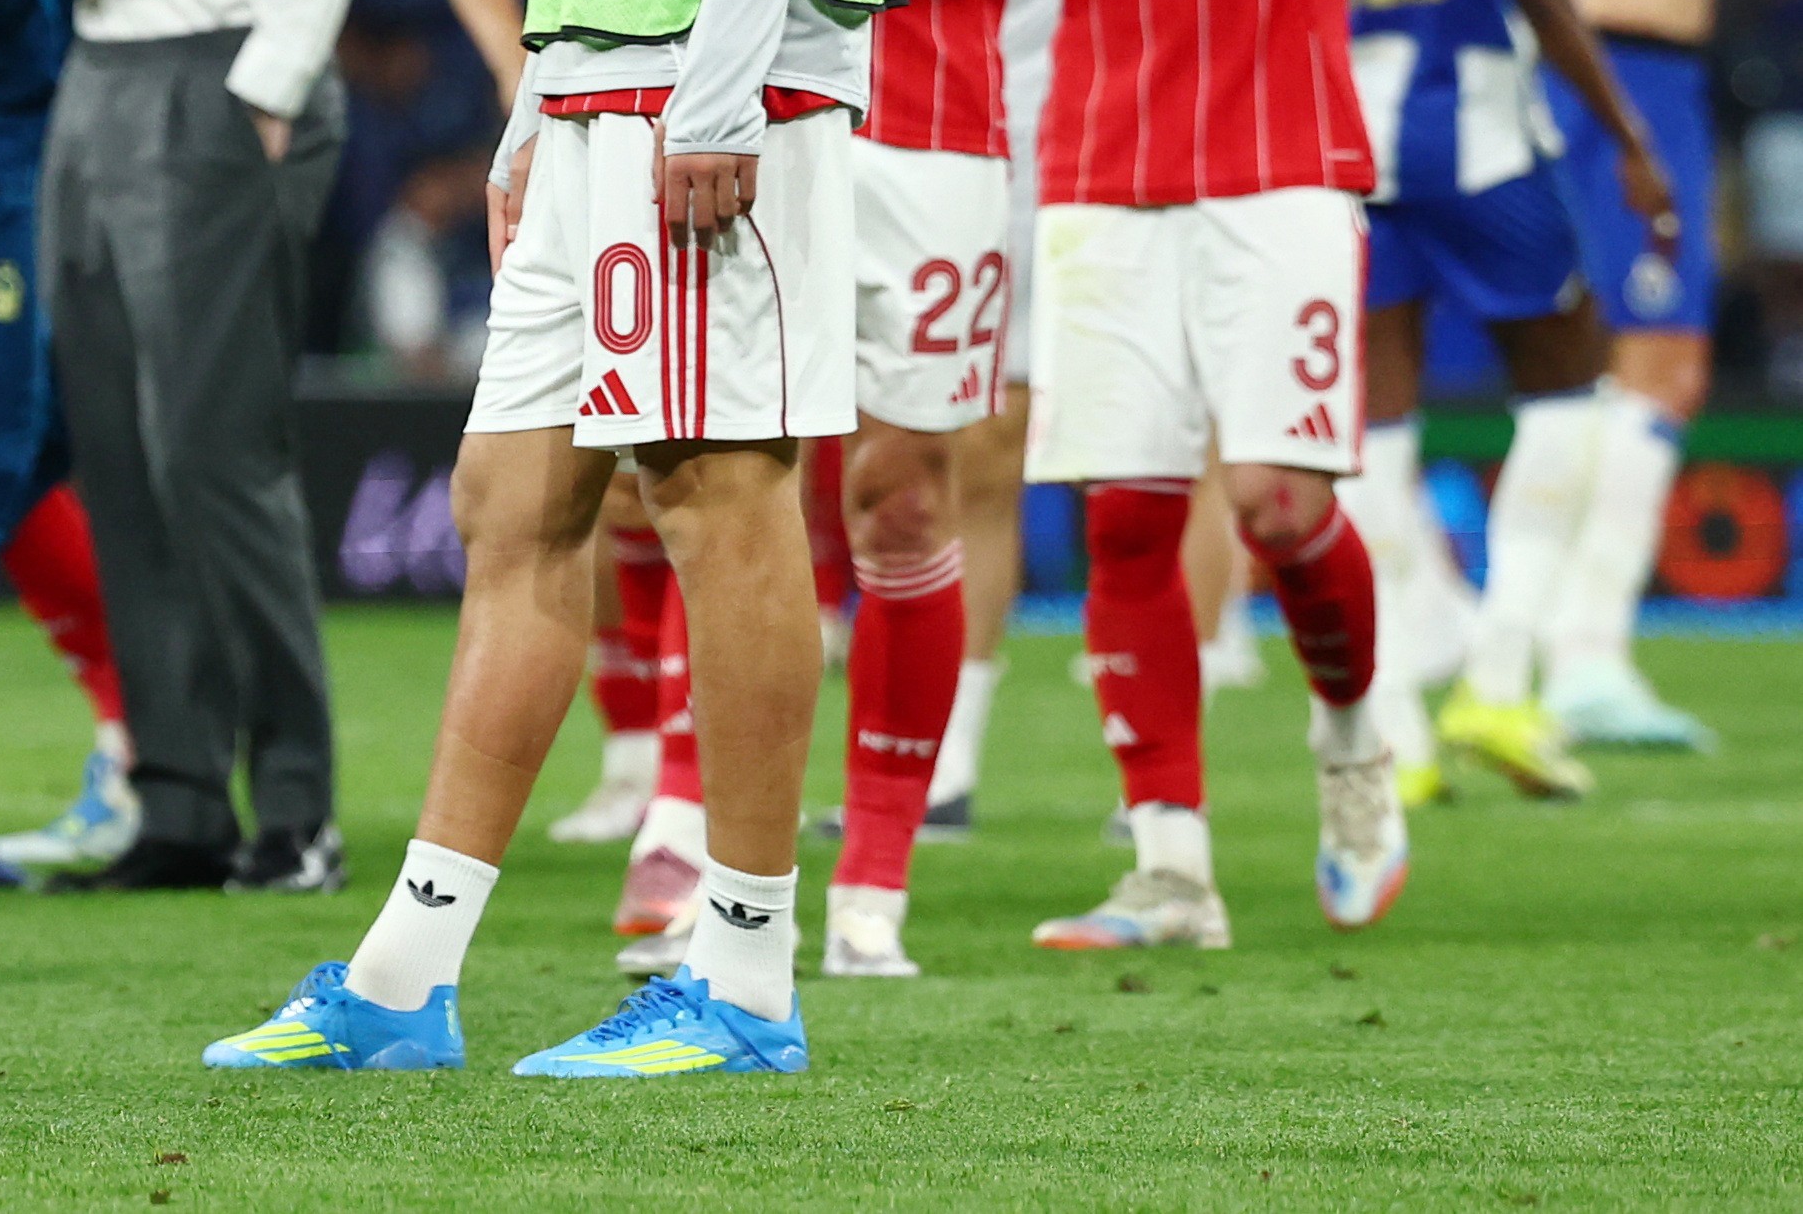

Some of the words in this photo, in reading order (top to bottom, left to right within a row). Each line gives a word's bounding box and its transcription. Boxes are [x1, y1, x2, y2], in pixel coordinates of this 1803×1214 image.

[594, 242, 653, 355] 0
[911, 250, 1004, 353] 22
[1292, 298, 1341, 392] 3
